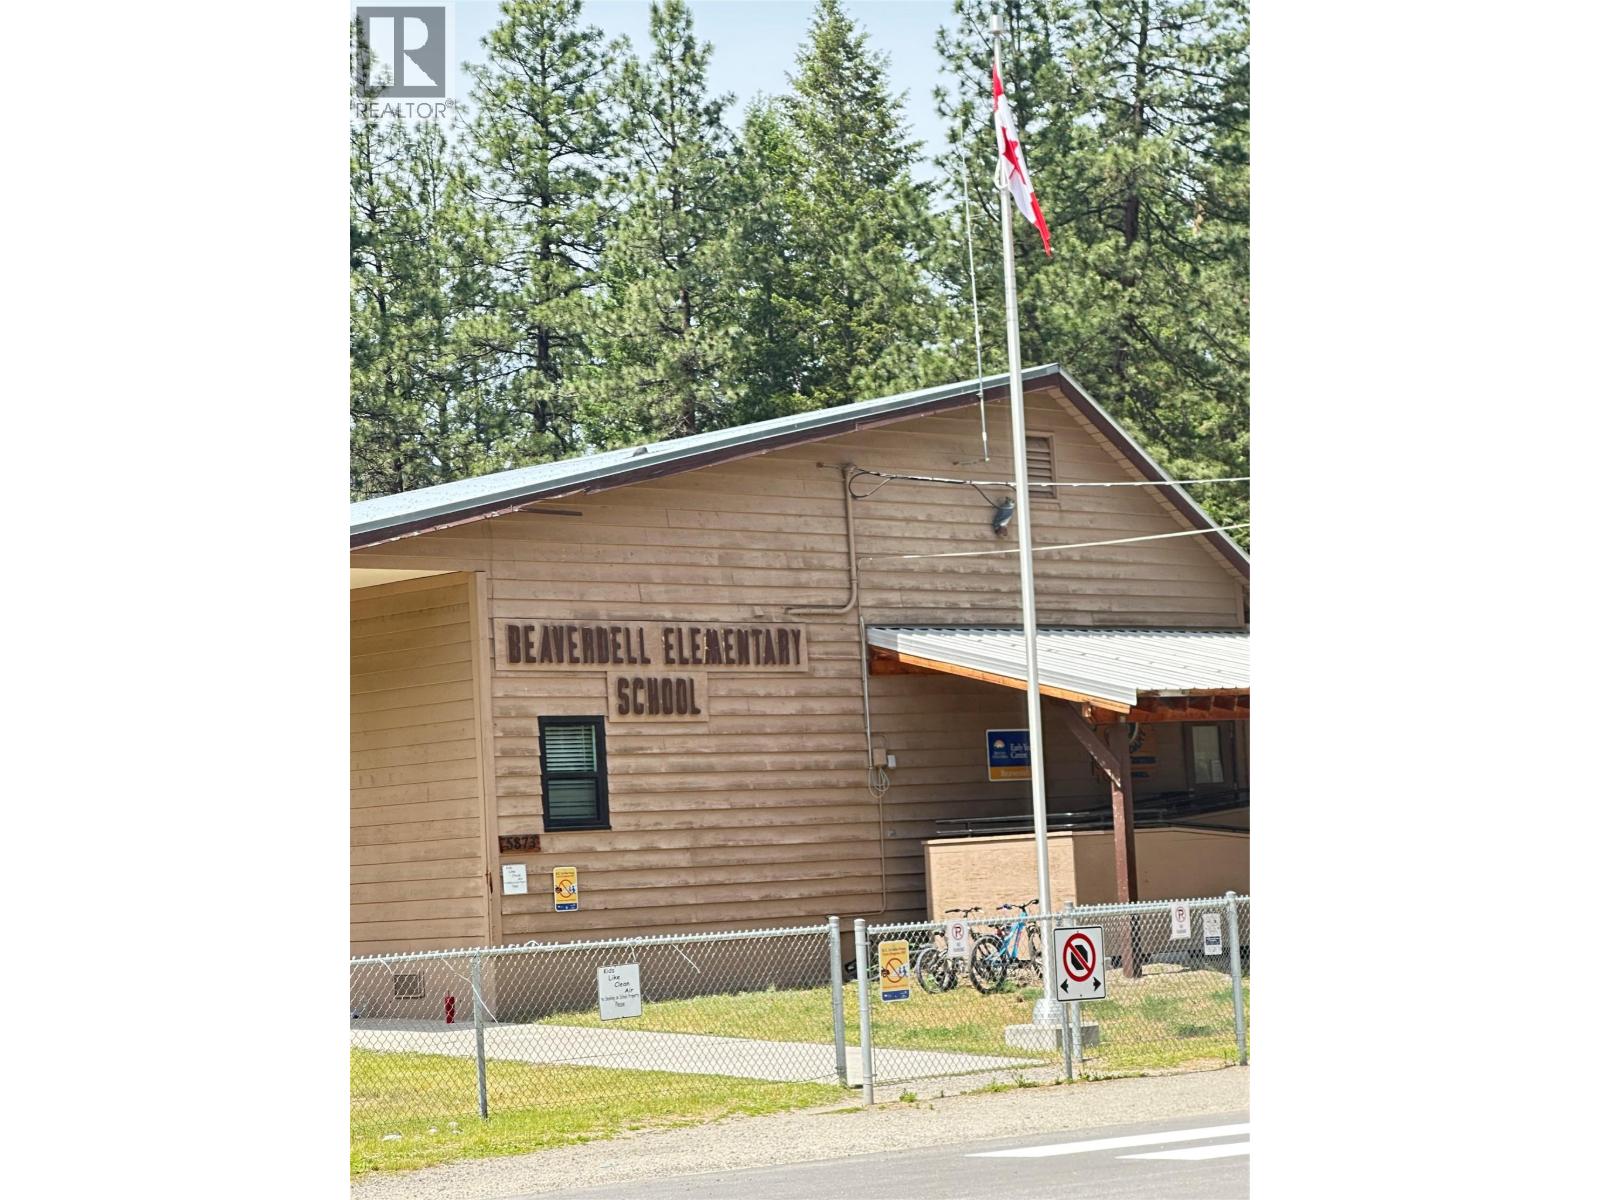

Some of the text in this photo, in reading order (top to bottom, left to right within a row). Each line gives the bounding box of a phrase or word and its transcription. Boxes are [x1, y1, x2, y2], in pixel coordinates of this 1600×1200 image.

[506, 624, 801, 666] BEAVERDELL ELEMENTARY
[616, 676, 702, 716] SCHOOL
